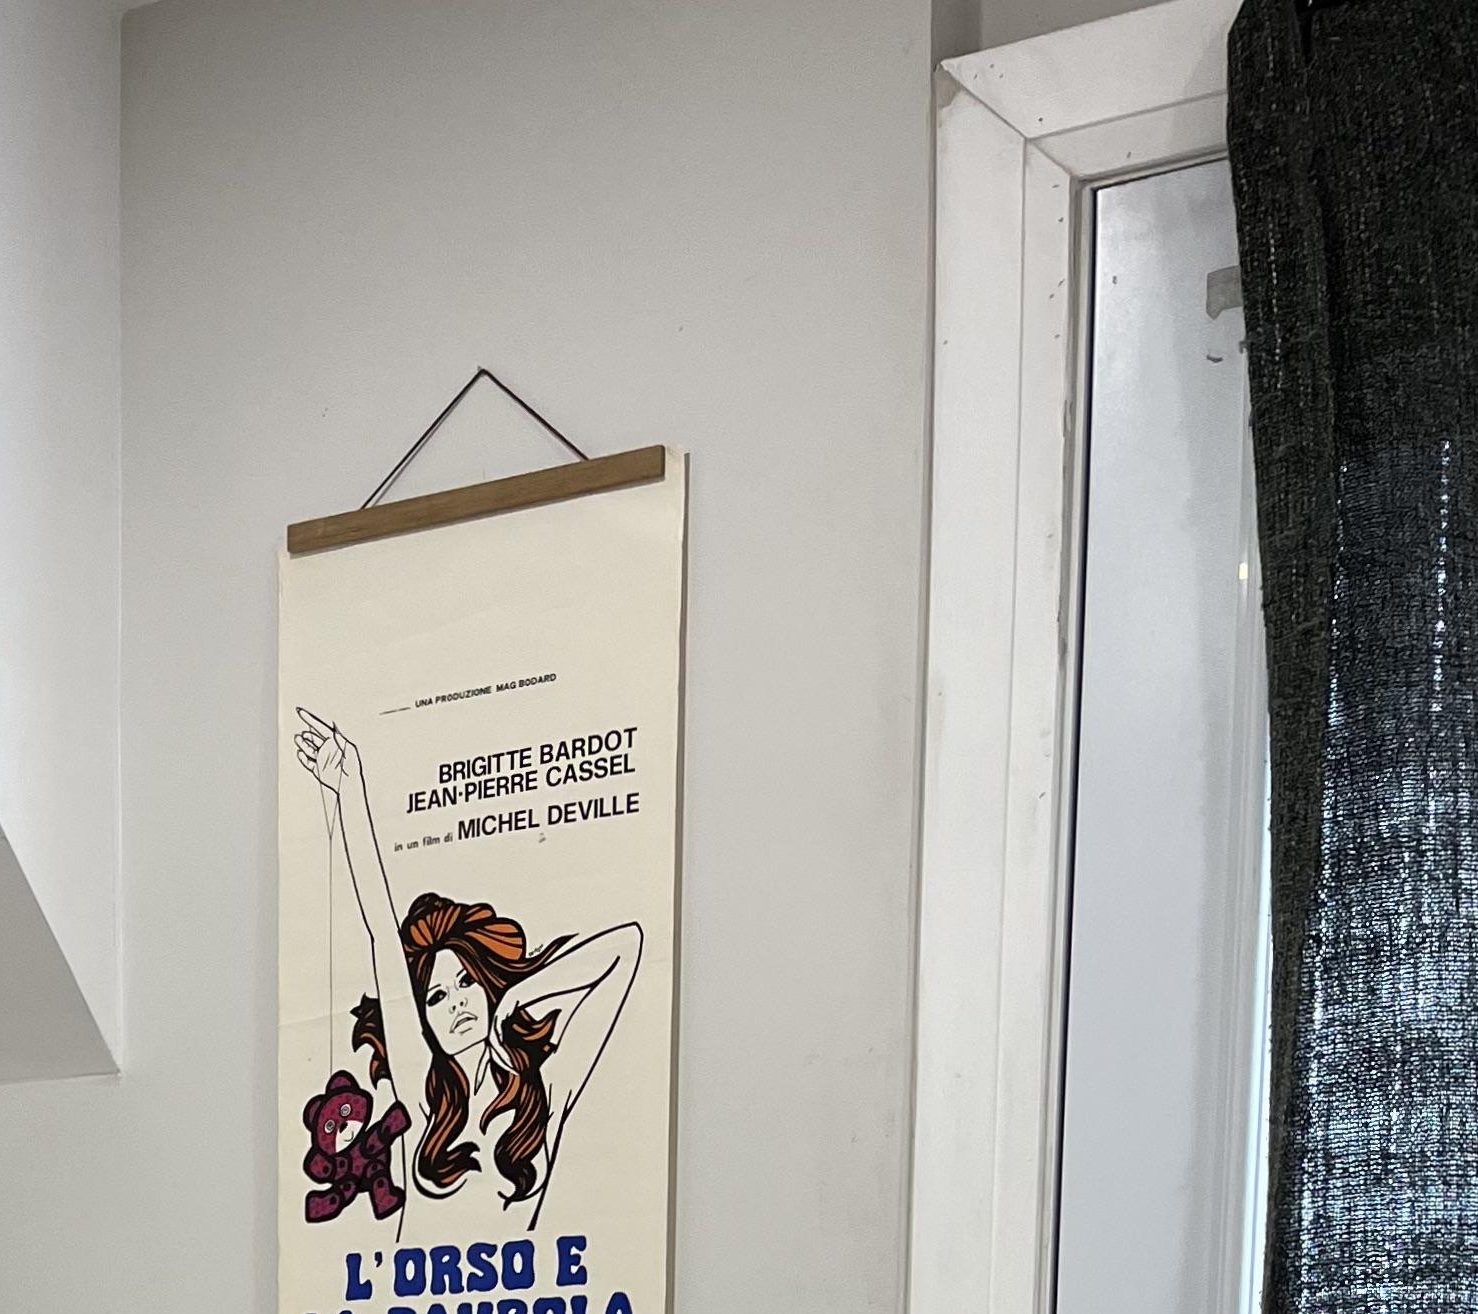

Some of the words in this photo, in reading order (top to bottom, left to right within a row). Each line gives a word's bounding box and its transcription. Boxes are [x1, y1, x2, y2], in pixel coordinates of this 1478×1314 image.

[415, 698, 433, 708] UNA
[435, 686, 492, 704] PRODUZIONE
[496, 681, 517, 693] MAG
[518, 673, 557, 688] BODARD
[439, 747, 532, 784] BRIGITTE
[539, 727, 638, 766] BARDOT
[546, 753, 636, 788] CASSEL
[394, 841, 403, 852] in
[406, 840, 419, 850] un
[423, 835, 440, 848] film
[444, 832, 453, 843] di
[458, 809, 540, 840] MICHEL
[548, 792, 640, 826] DEVILLE
[345, 1239, 535, 1301] L'ORSO
[556, 1235, 588, 1287] E
